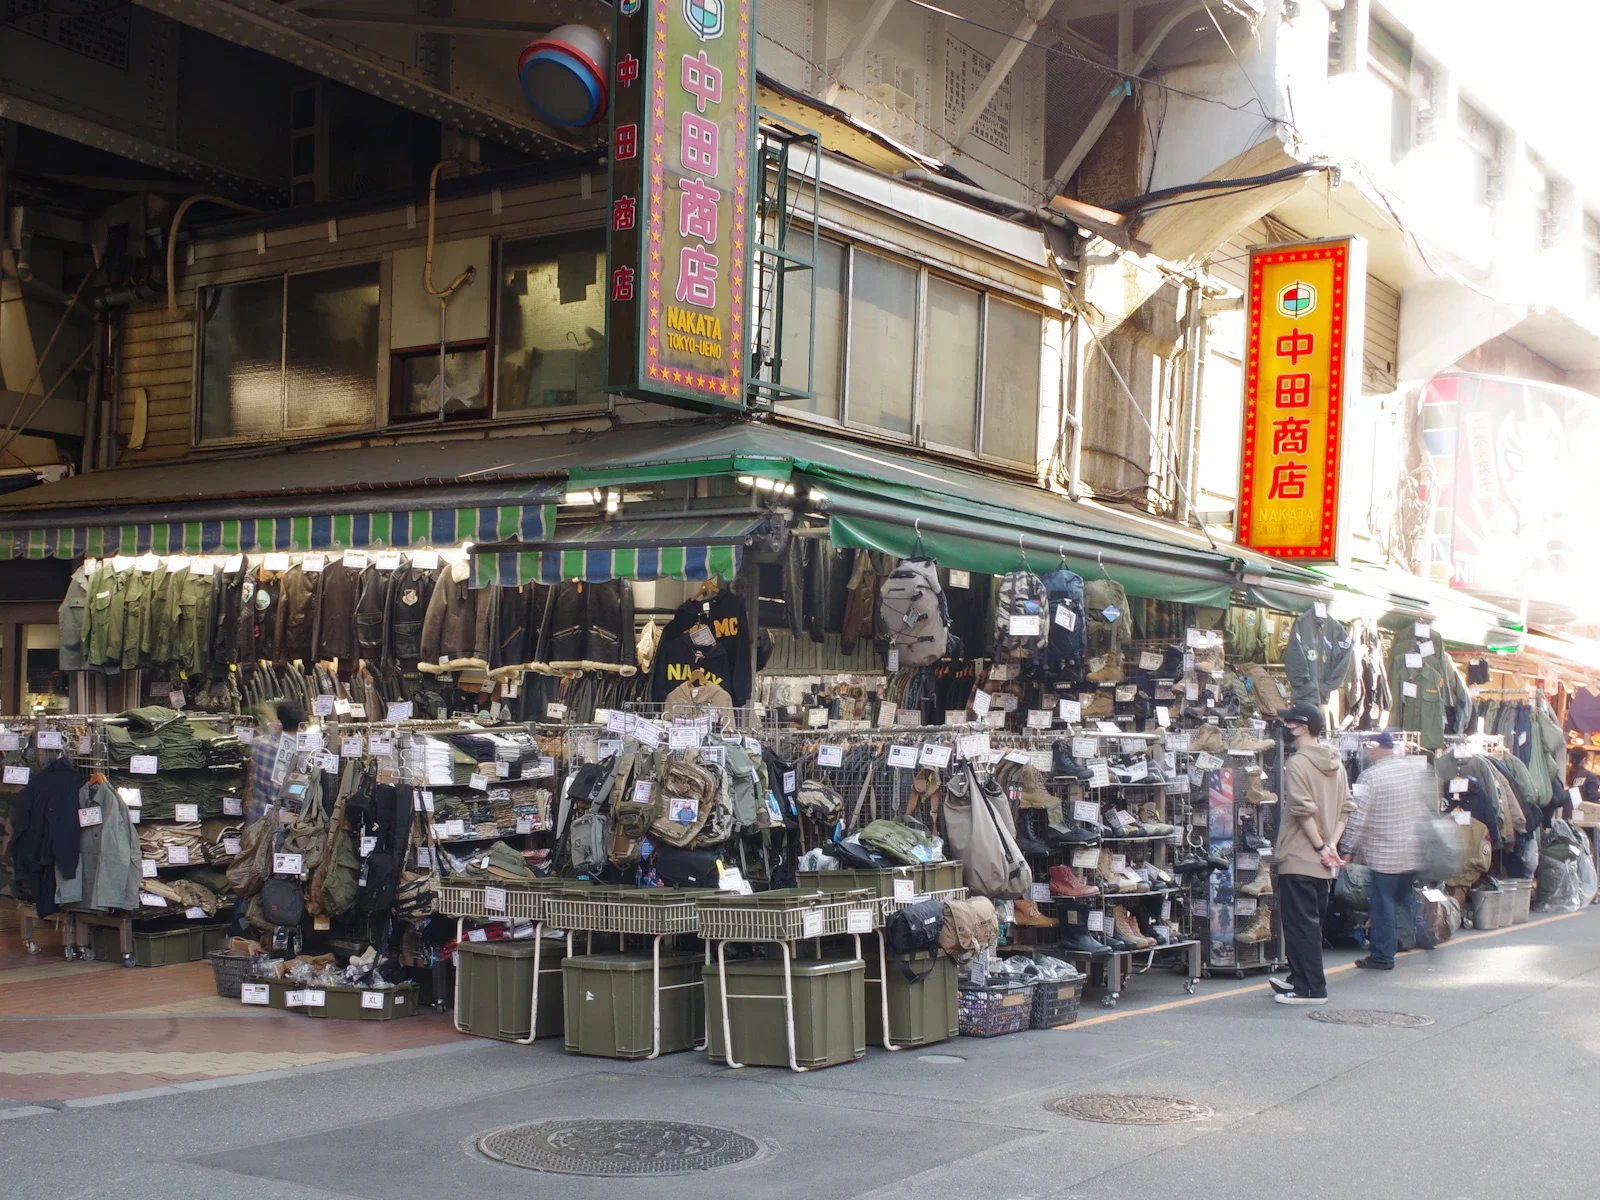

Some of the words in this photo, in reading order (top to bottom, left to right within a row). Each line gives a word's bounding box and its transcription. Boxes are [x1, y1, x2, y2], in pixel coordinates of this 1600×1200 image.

[612, 53, 640, 301] 中田商店
[675, 50, 723, 309] 中田商店
[667, 305, 722, 341] NAKATA
[667, 332, 722, 360] TOKYO-UENO
[1267, 327, 1316, 501] 中田商店
[1259, 507, 1315, 521] NAKATA
[713, 616, 738, 638] MC
[292, 994, 302, 1002] XL
[311, 994, 317, 1002] L
